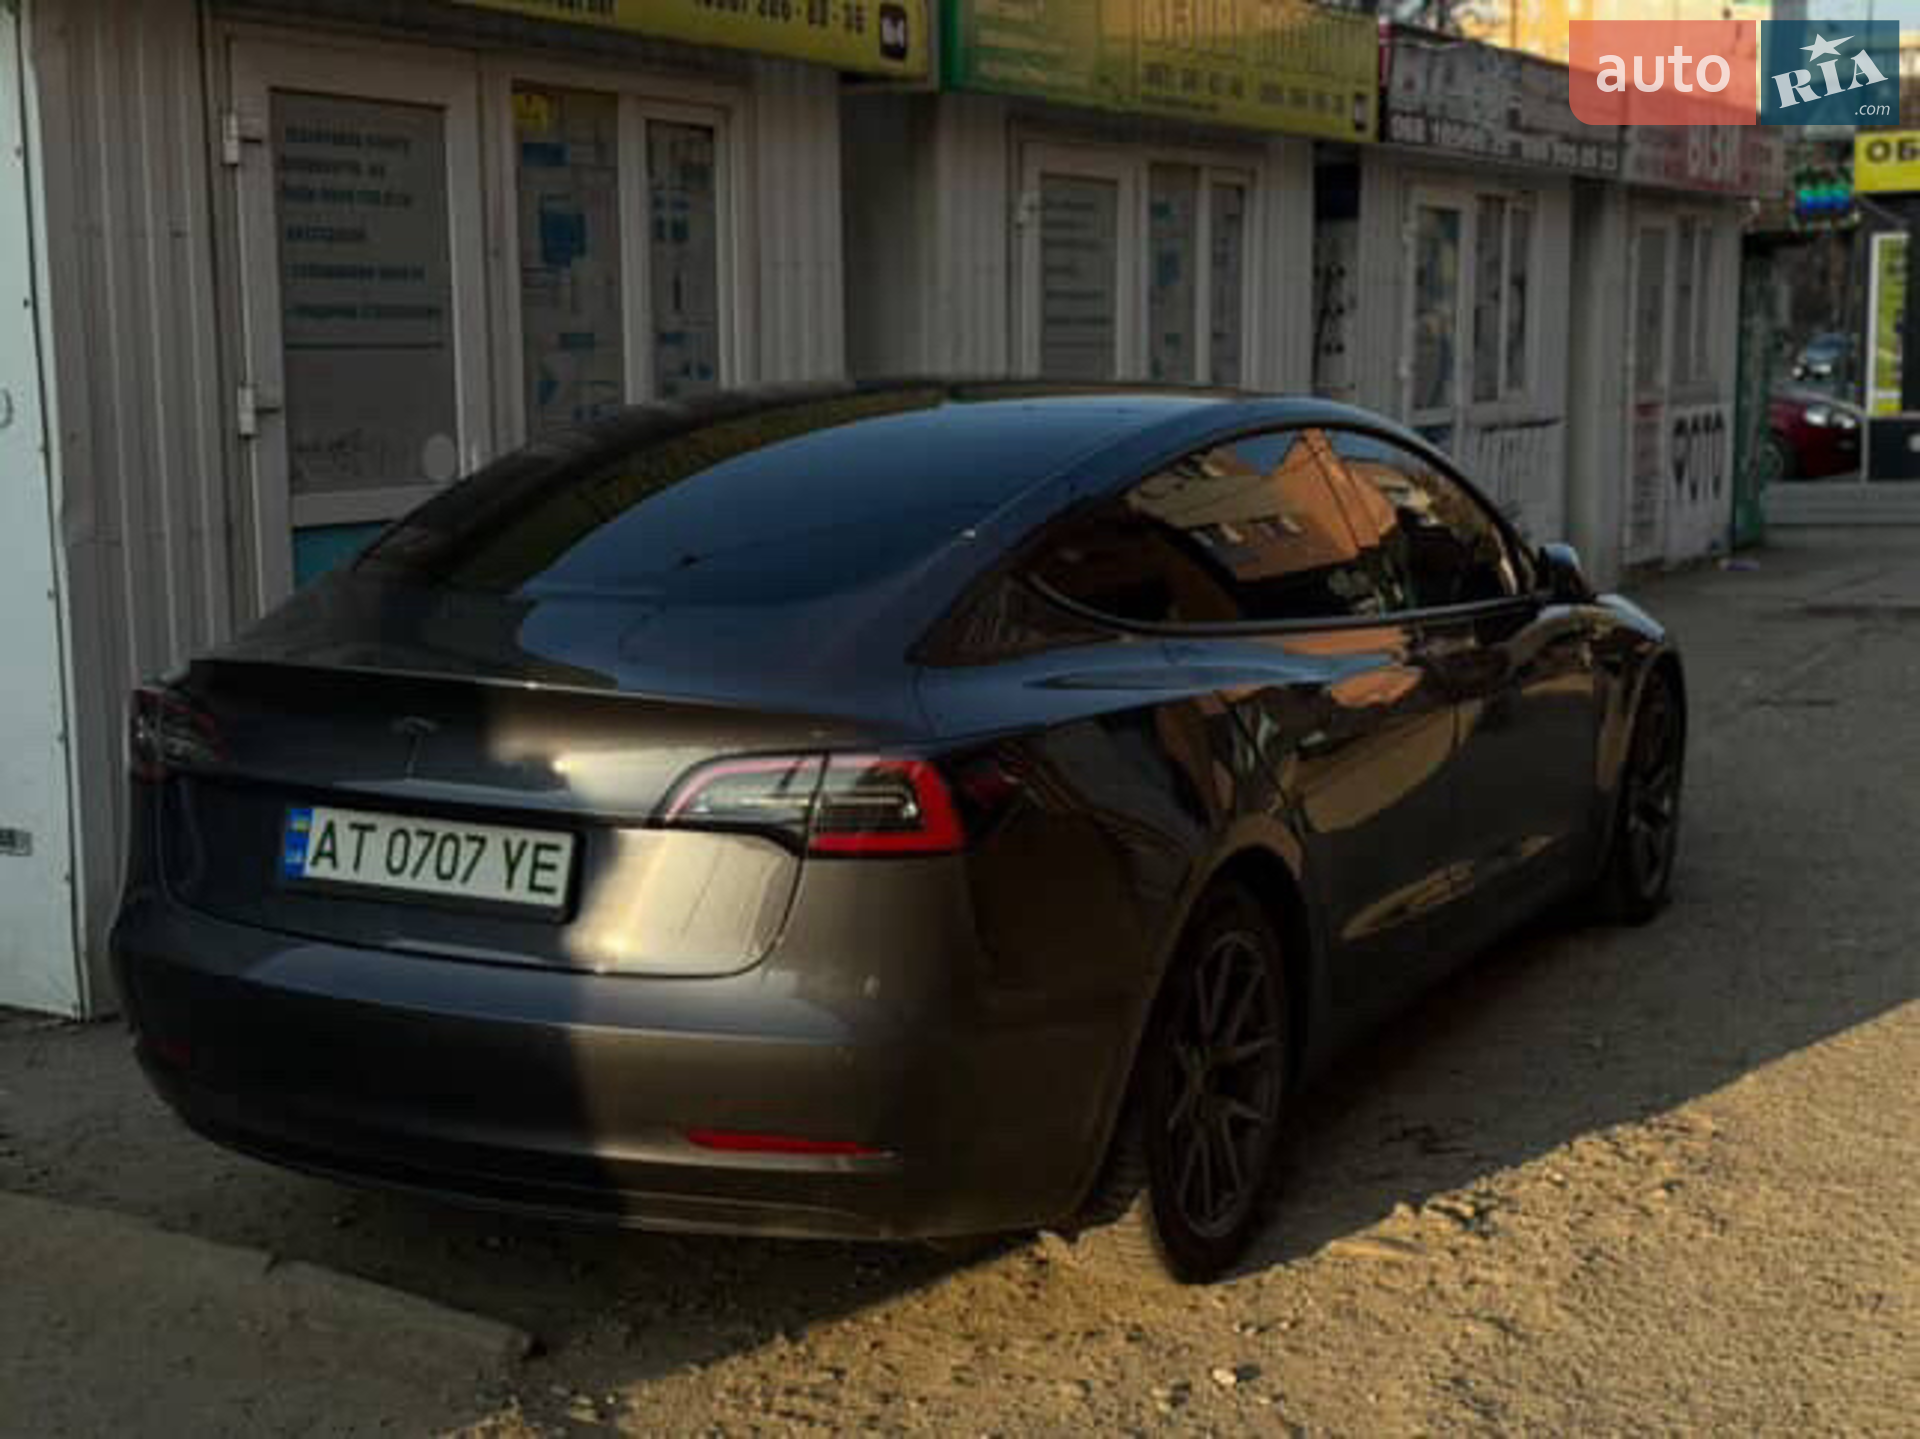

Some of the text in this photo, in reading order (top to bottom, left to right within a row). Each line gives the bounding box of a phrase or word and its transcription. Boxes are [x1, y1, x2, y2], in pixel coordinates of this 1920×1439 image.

[310, 820, 563, 895] AT 0707 YE
